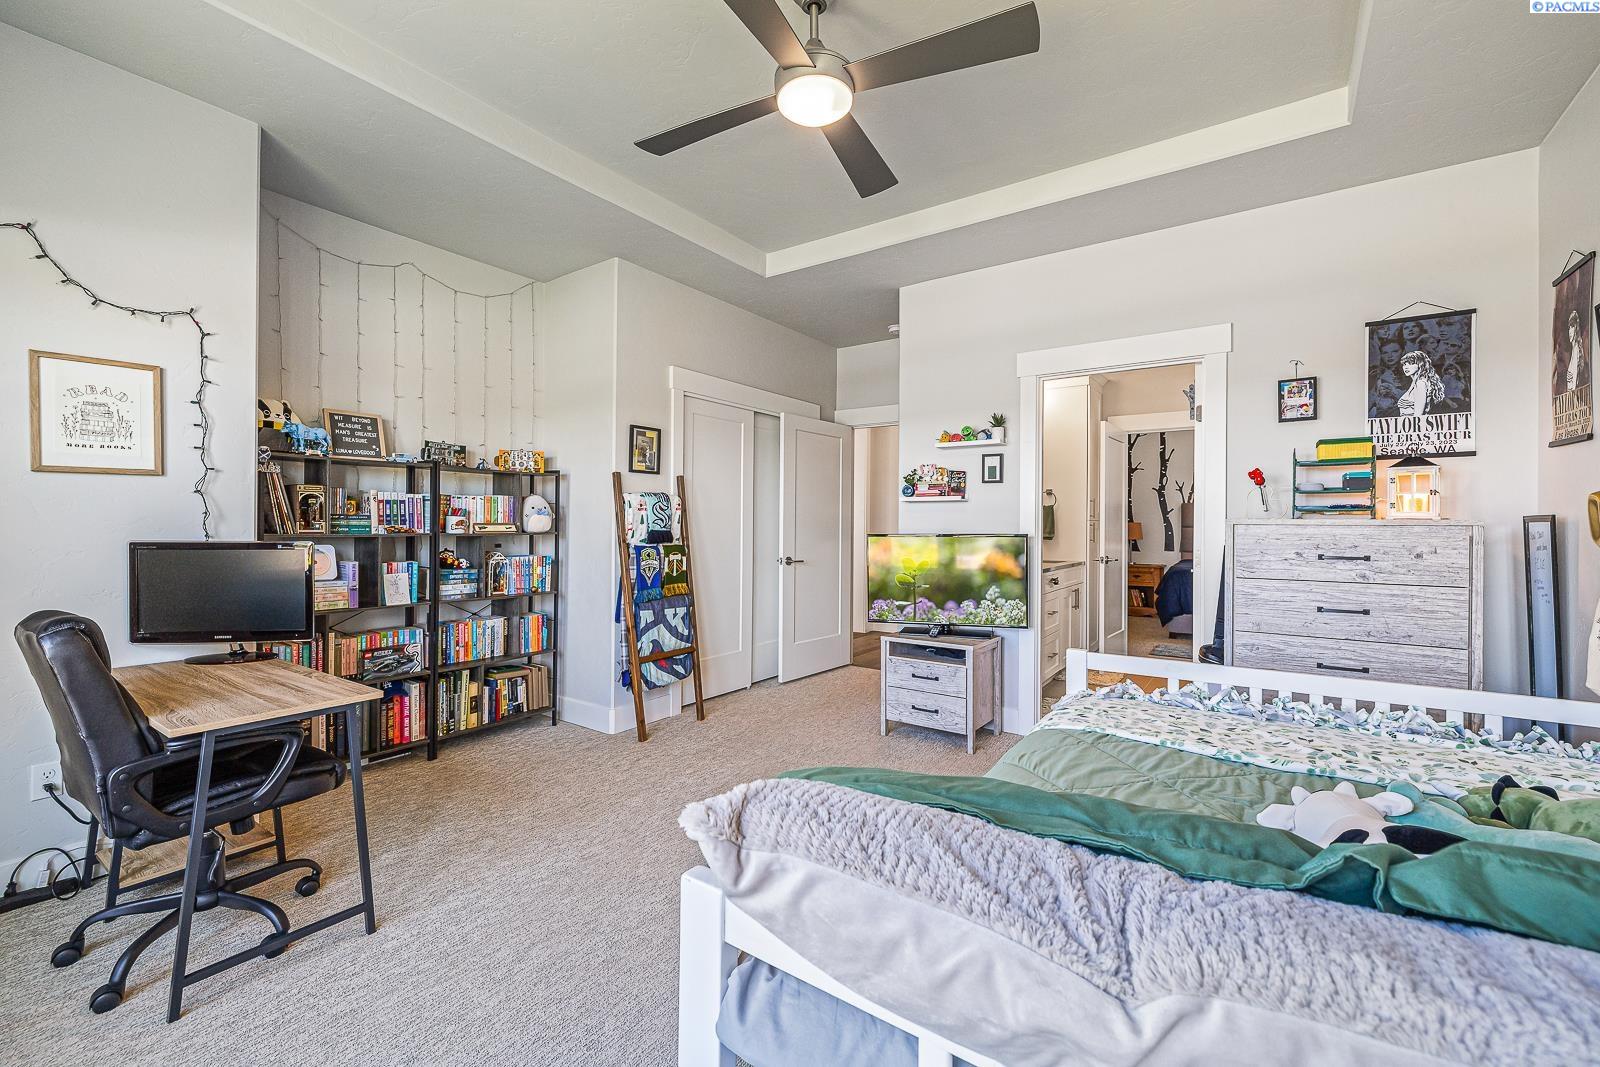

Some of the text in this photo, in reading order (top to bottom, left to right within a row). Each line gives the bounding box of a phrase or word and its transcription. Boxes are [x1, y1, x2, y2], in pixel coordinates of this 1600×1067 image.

[67, 384, 128, 402] READ
[337, 422, 362, 430] MEASURE
[1368, 413, 1472, 435] TAYLOR SWIFT
[342, 436, 368, 444] TREASURE
[1397, 433, 1431, 443] ERAS
[1435, 430, 1472, 440] TOUR
[1434, 445, 1456, 453] WA
